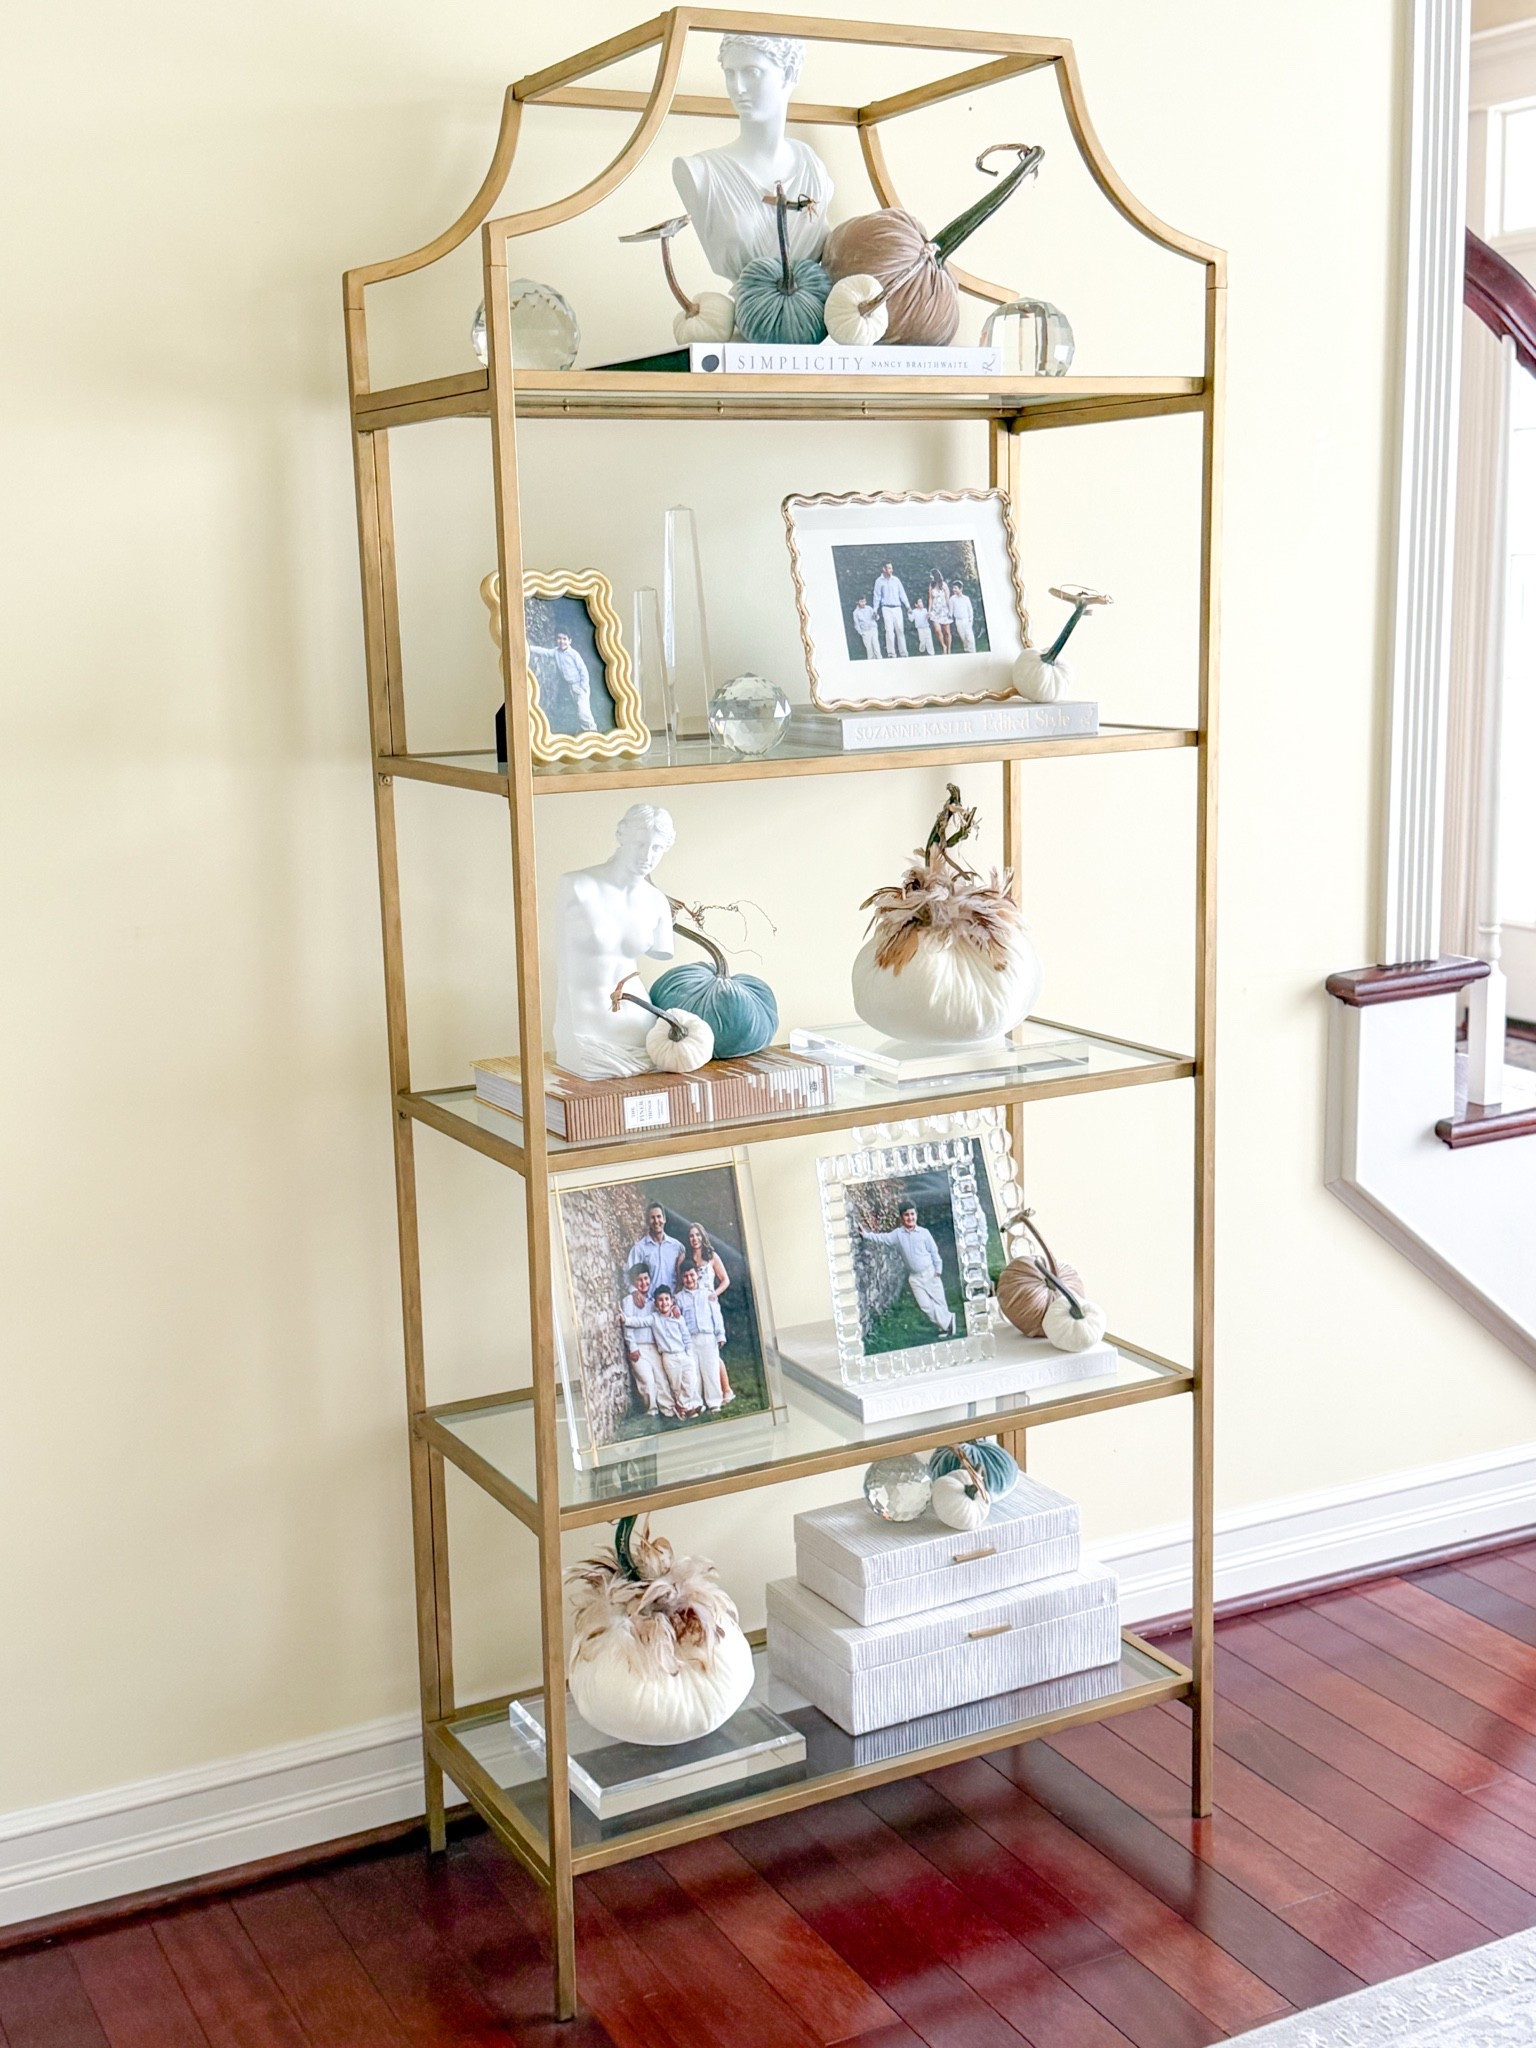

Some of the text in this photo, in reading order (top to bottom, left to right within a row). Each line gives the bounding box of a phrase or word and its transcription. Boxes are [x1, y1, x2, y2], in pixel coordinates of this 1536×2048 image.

[737, 355, 863, 371] SIMPLICITY
[906, 361, 968, 369] BRAITHWAITE
[855, 724, 920, 742] SUZANNE
[924, 720, 973, 737] KASLER
[983, 709, 1030, 733] Edited
[1035, 708, 1072, 736] Style
